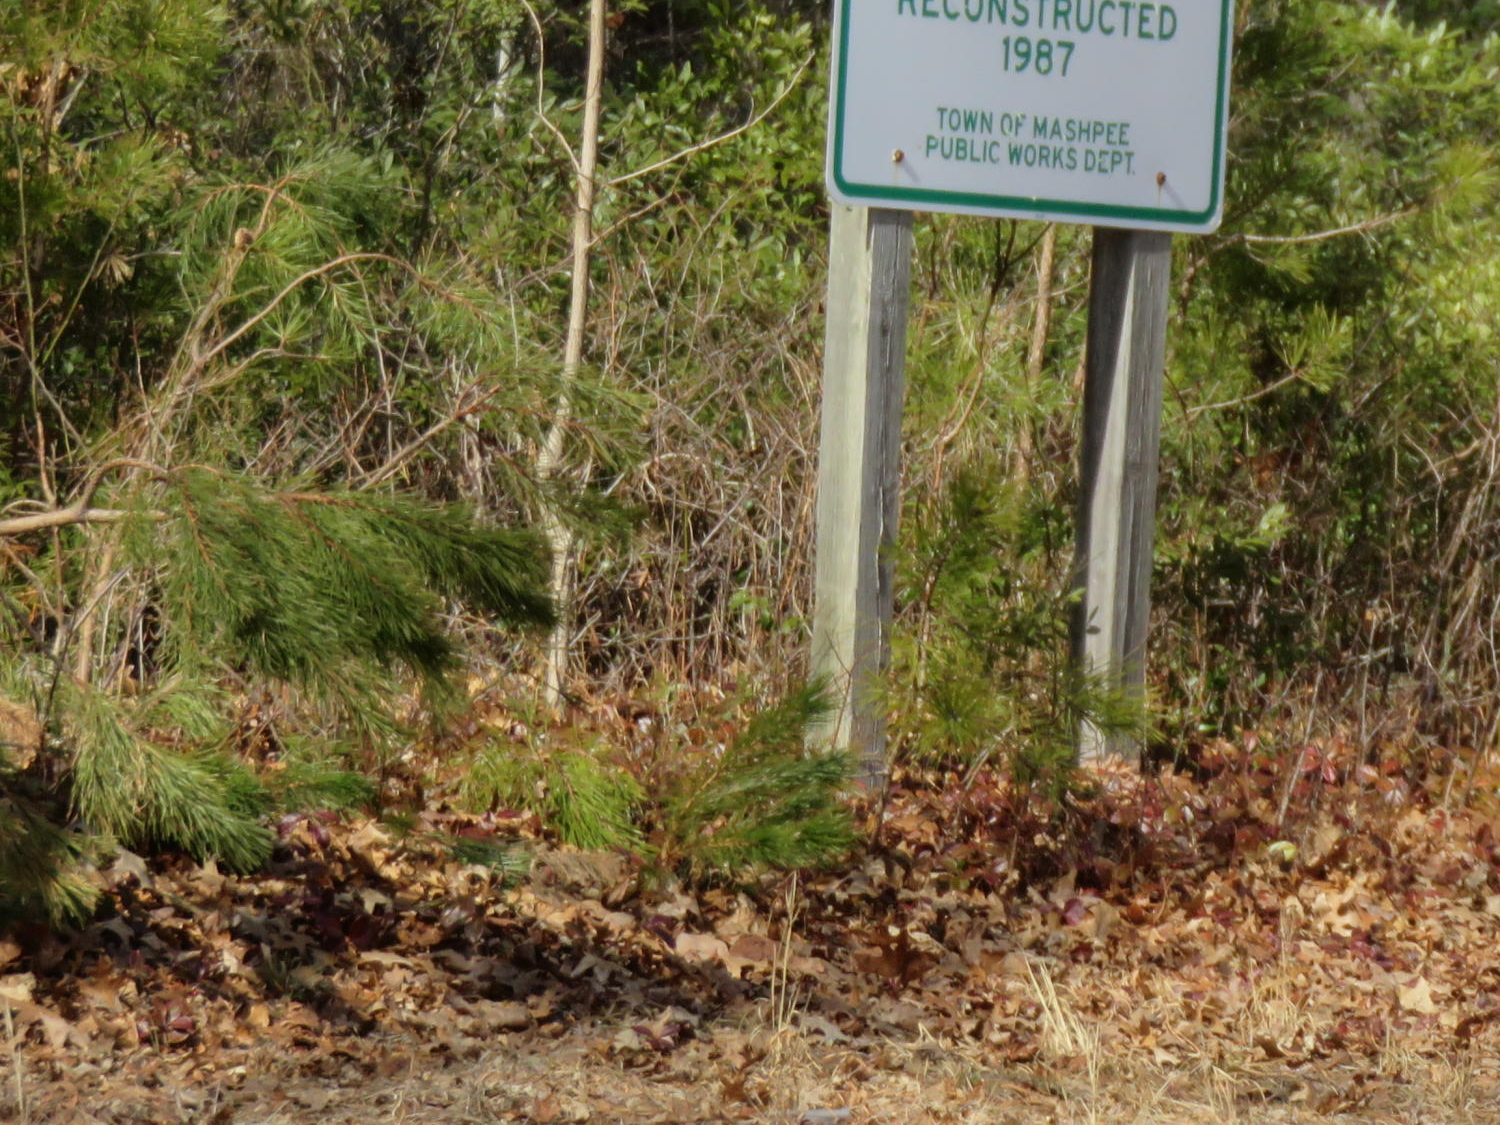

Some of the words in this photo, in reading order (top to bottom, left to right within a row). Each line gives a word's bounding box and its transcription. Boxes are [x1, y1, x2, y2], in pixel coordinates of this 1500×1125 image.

[1002, 37, 1075, 76] 1987
[937, 107, 993, 134] TOWN
[1001, 113, 1026, 136] OF
[1033, 116, 1130, 146] MASHPEE
[926, 135, 1000, 163] PUBLIC
[1008, 143, 1077, 170] WORKS
[1085, 149, 1135, 175] DEPT.
